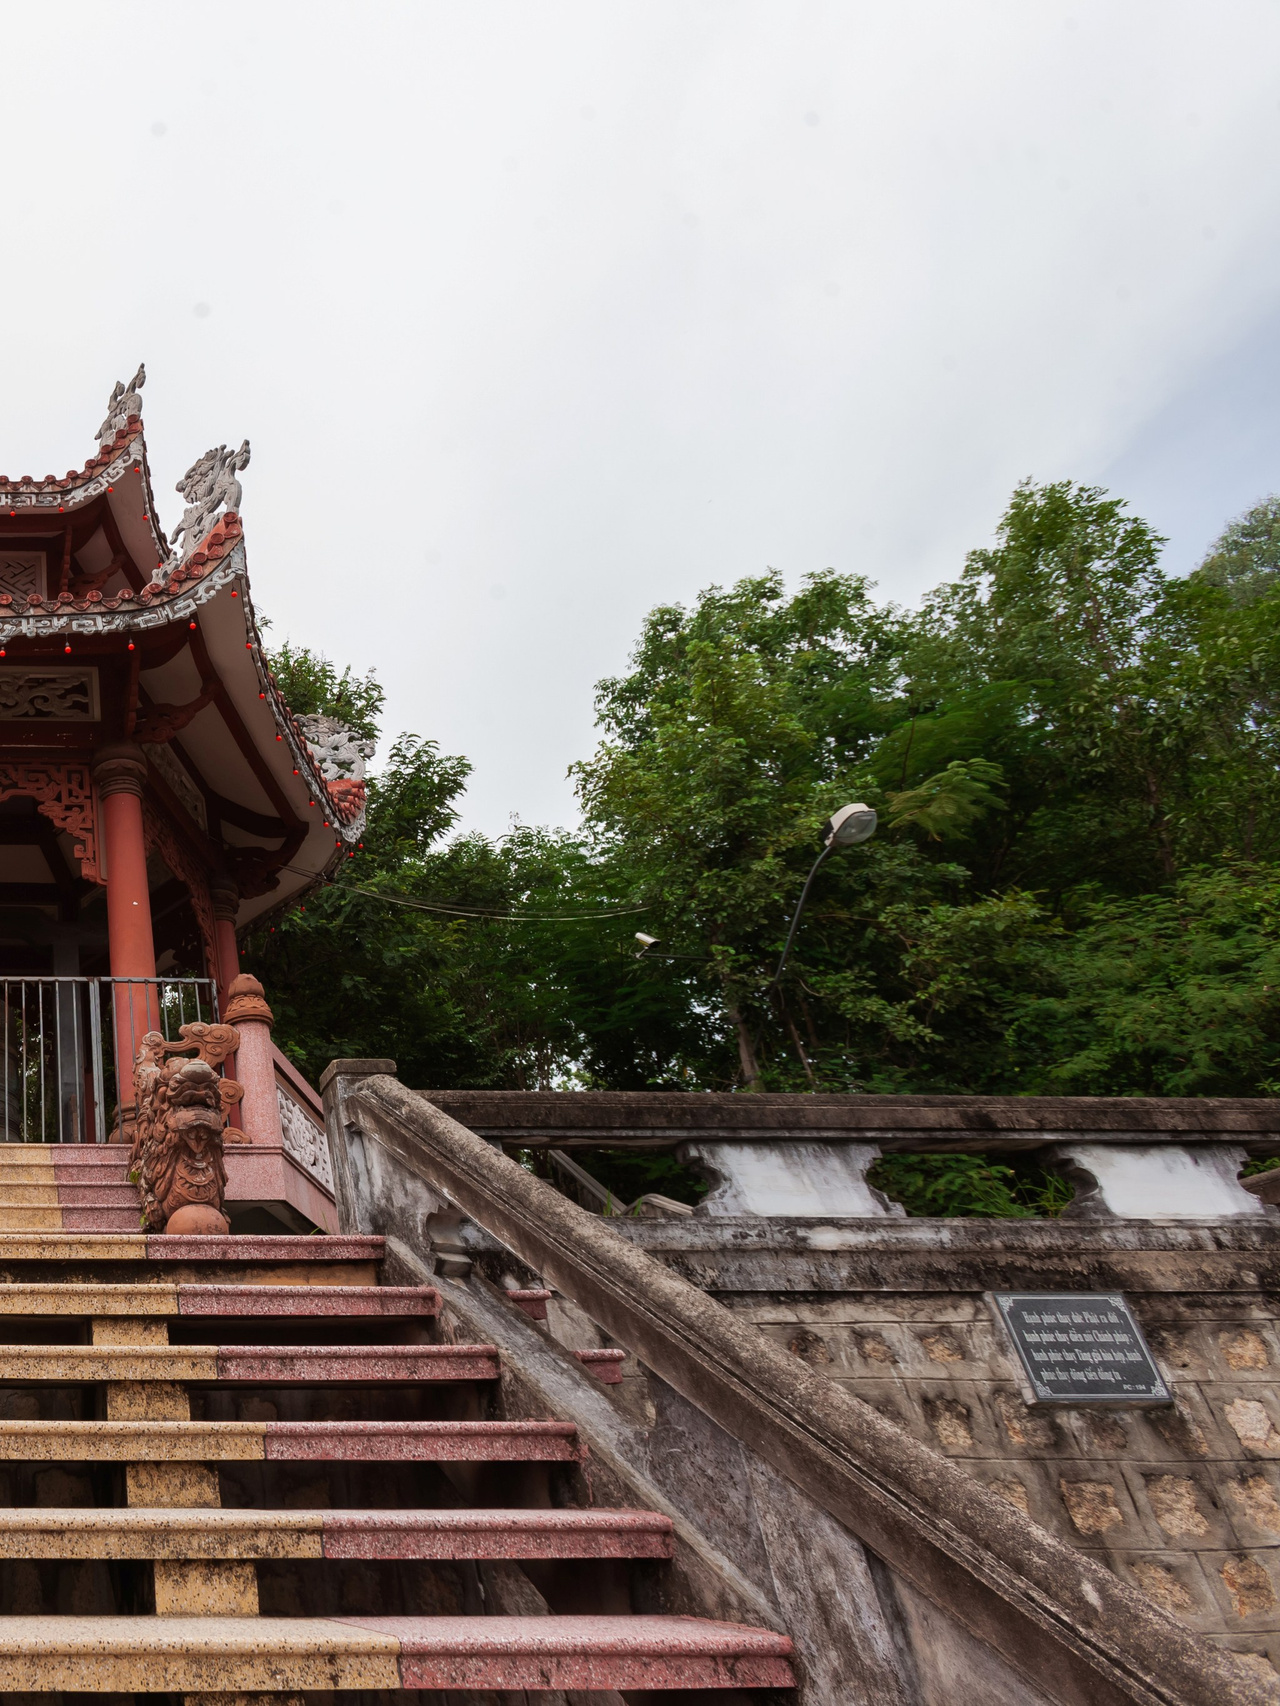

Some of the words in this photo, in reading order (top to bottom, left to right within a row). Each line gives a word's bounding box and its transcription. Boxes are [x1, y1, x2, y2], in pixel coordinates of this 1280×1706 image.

[1021, 1311, 1042, 1325] Hạnh
[1040, 1311, 1057, 1326] phúc
[1056, 1311, 1072, 1325] thay
[1082, 1311, 1100, 1325] Phật
[1099, 1315, 1109, 1323] ra
[1021, 1330, 1041, 1344] hạnh
[1039, 1330, 1056, 1345] phúc
[1054, 1330, 1070, 1344] thay
[1030, 1349, 1050, 1363] hạnh
[1047, 1349, 1064, 1364] phúc
[1062, 1349, 1078, 1364] thay
[1040, 1368, 1058, 1383] phúc
[1055, 1367, 1071, 1383] thay
